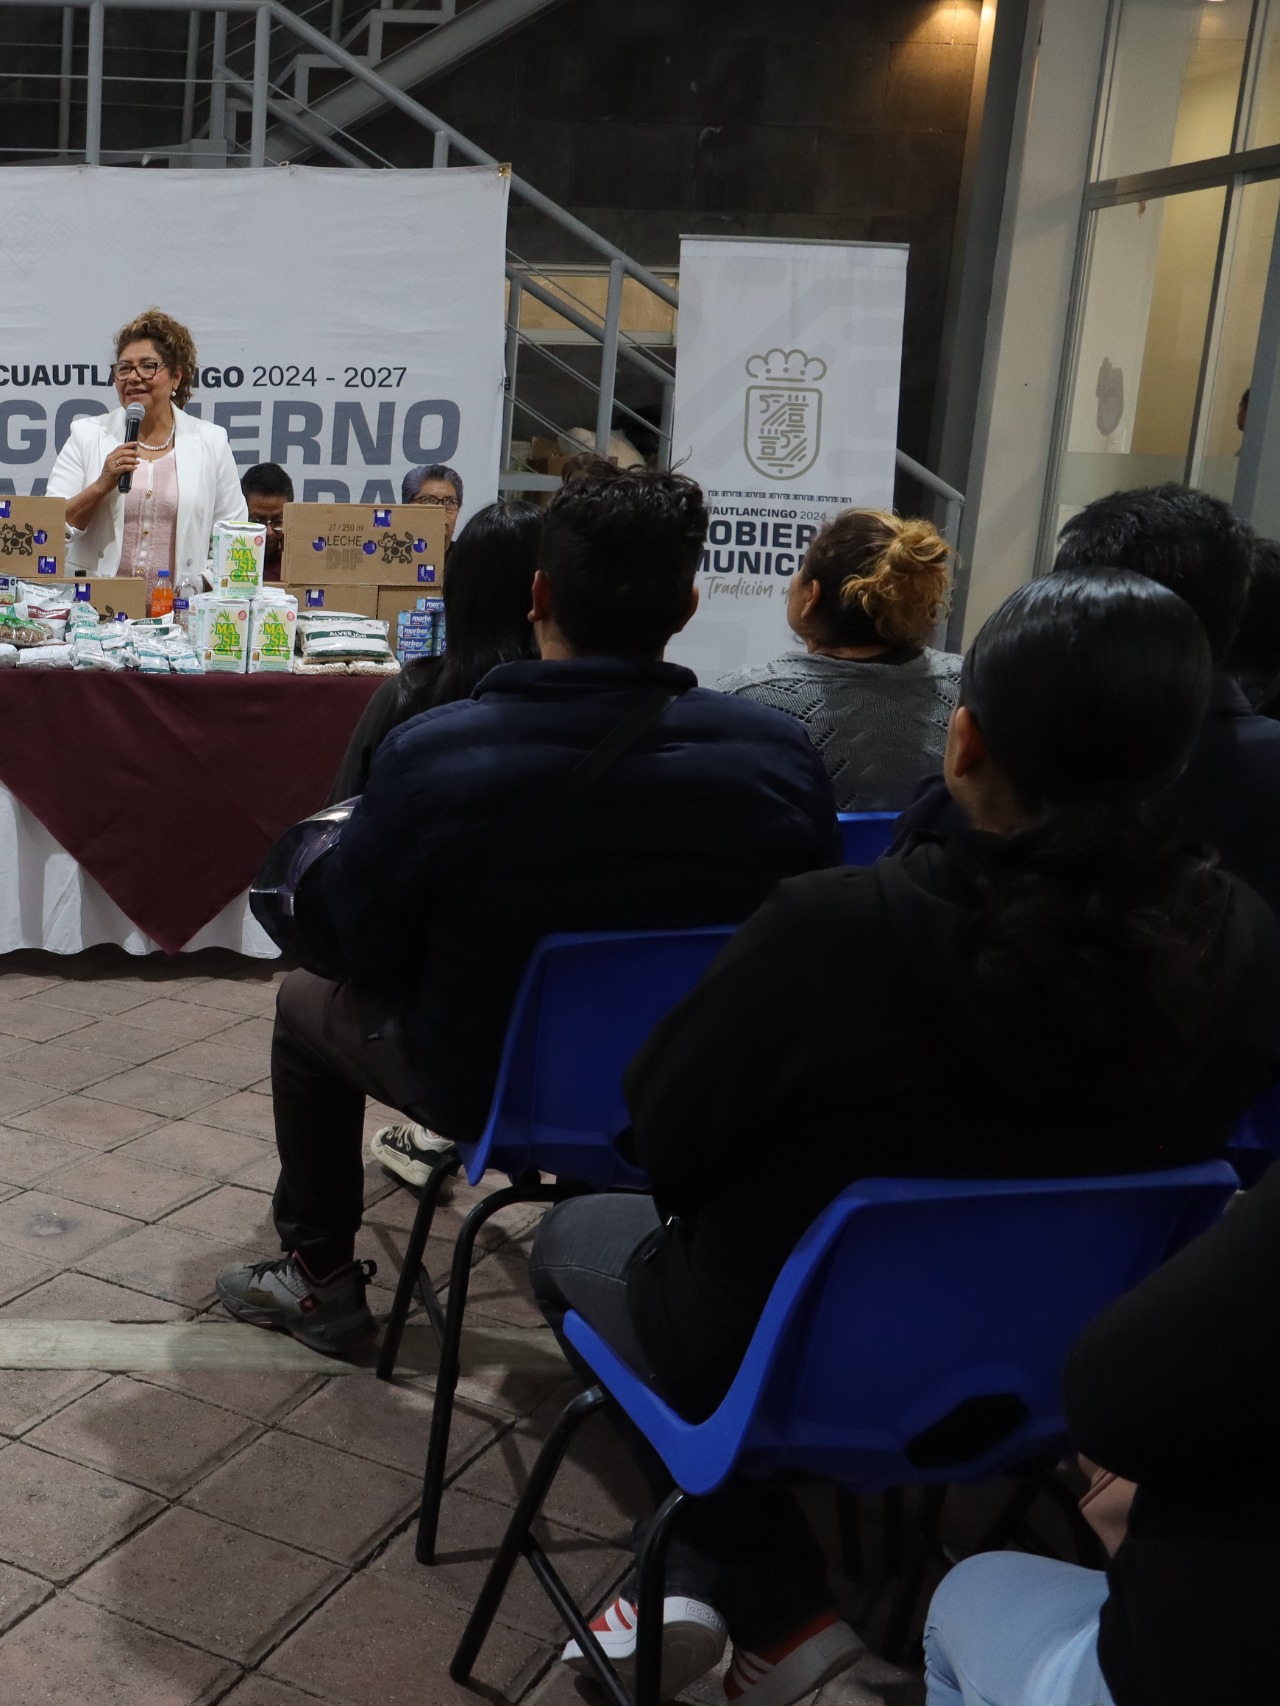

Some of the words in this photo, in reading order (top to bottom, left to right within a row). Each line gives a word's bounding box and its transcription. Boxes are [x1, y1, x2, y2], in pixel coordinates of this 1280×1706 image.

[252, 365, 318, 387] 2024
[344, 366, 408, 388] 2027
[707, 506, 798, 519] AUTLANCINGO
[800, 511, 827, 521] 2024
[328, 523, 337, 532] 27
[342, 523, 355, 532] 250
[709, 520, 818, 549] OBIER
[327, 535, 363, 547] LECHE
[231, 549, 253, 560] MA
[326, 548, 363, 570] DIF
[239, 560, 256, 571] SE
[696, 549, 808, 576] MUNIC
[230, 570, 249, 581] CA
[705, 575, 774, 600] Tradición
[215, 623, 236, 634] MA
[263, 623, 284, 634] MA
[222, 634, 240, 645] SE
[270, 634, 288, 646] SE
[214, 644, 233, 656] CA
[262, 644, 281, 656] CA
